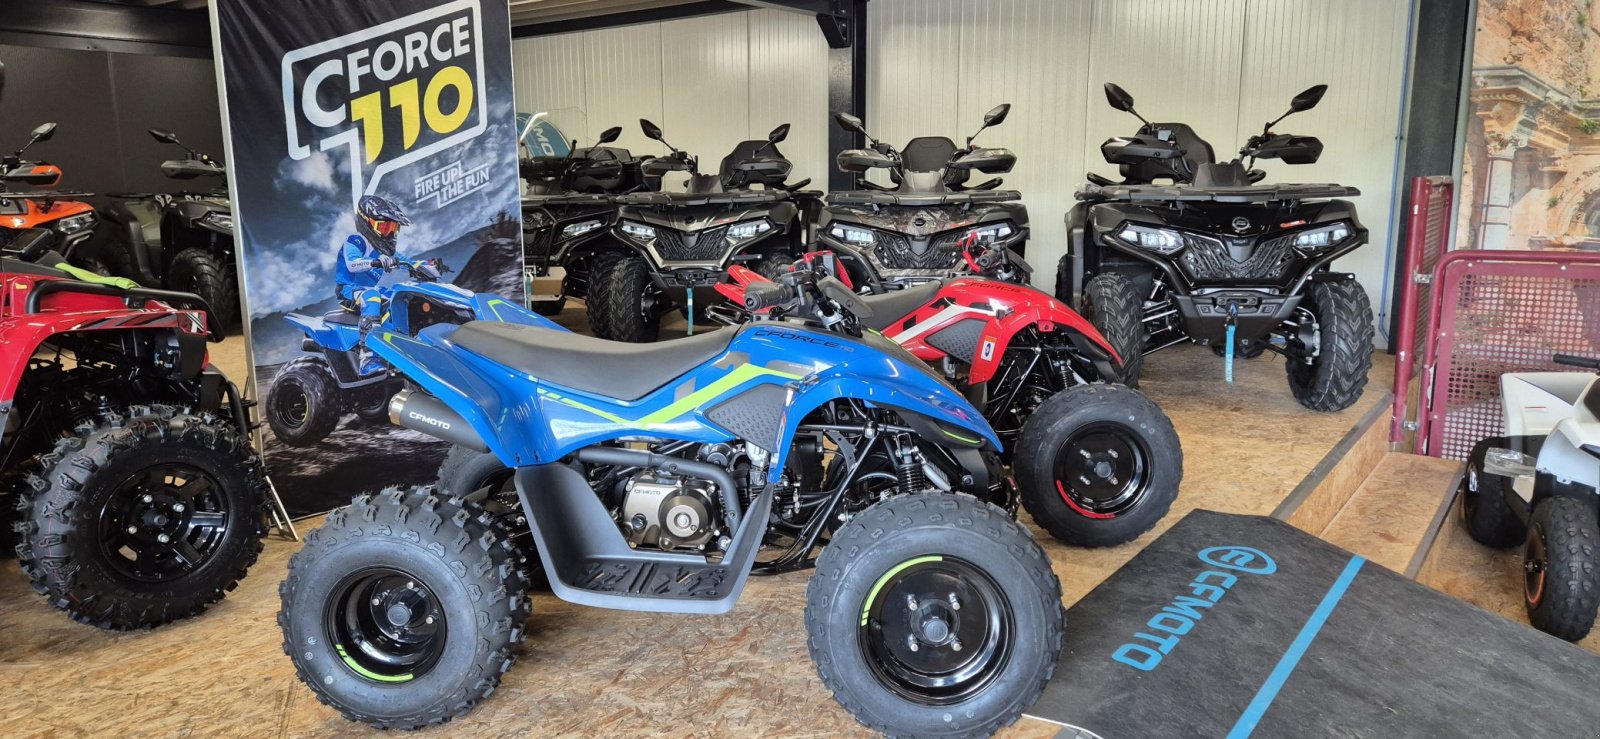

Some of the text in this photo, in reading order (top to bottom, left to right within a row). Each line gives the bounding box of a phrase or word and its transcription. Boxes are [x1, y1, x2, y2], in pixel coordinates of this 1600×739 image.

[302, 16, 470, 127] CFORCE
[350, 65, 474, 165] 110
[414, 167, 459, 199] FIRE UP
[440, 167, 490, 201] THE FUN
[754, 329, 839, 348] CFORCE
[409, 411, 452, 430] CFMOTO
[1111, 570, 1239, 672] CFMOTO
